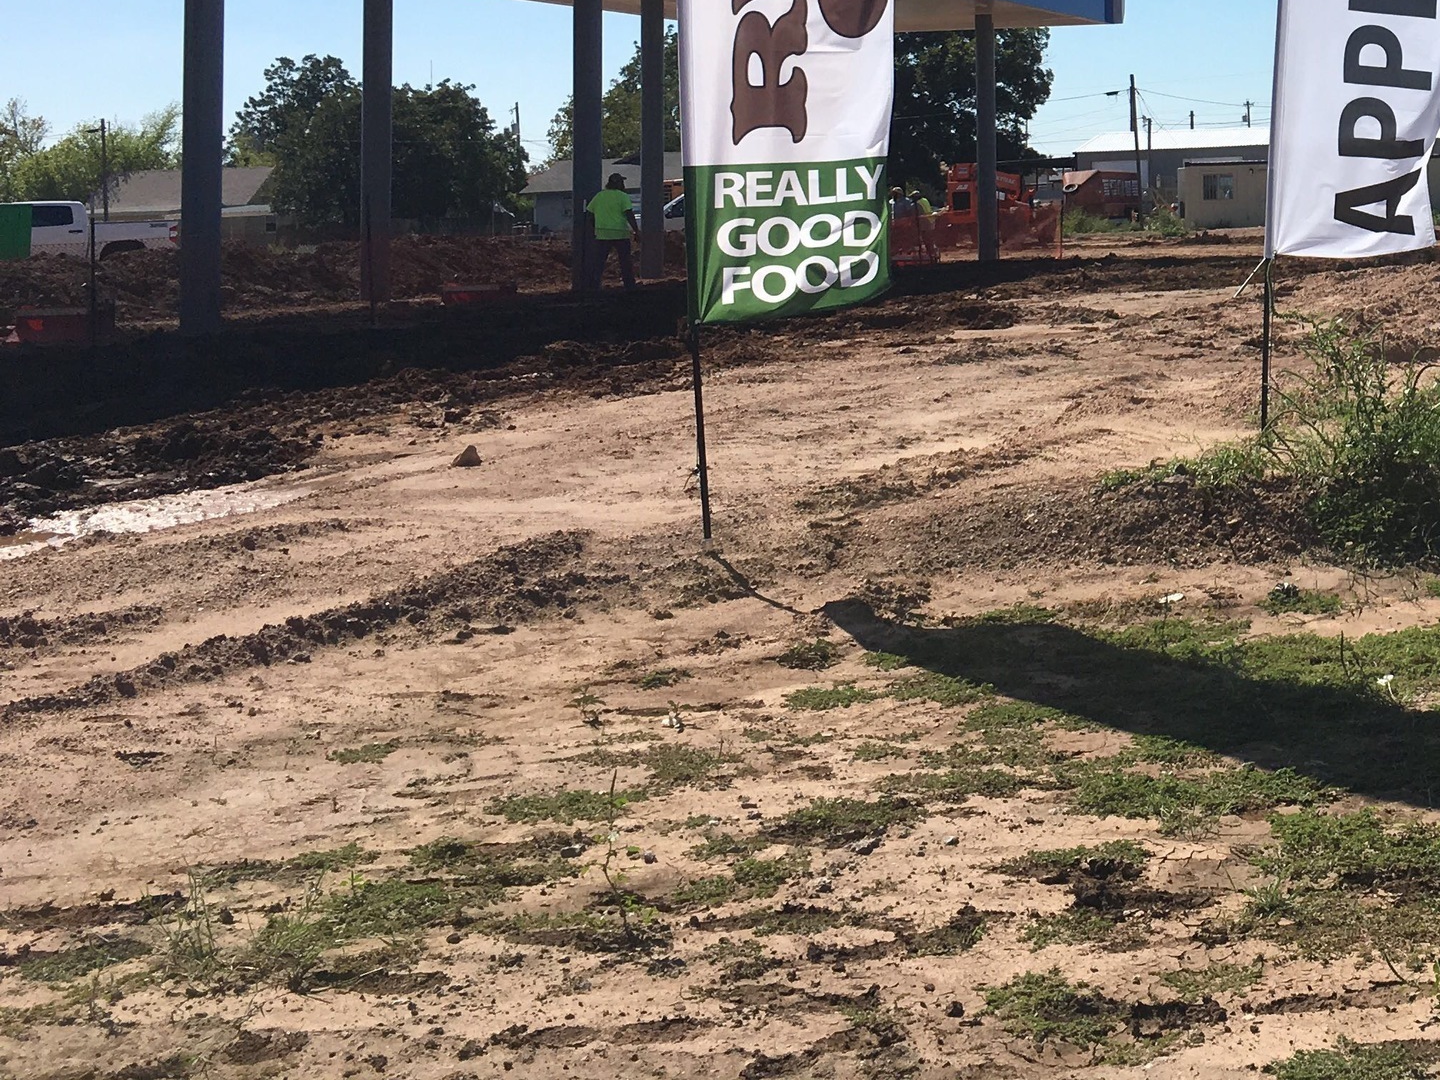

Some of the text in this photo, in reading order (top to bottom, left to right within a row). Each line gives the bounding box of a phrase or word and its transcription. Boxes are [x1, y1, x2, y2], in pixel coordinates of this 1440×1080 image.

[713, 164, 885, 209] REALLY
[717, 209, 882, 258] GOOD
[721, 250, 880, 305] FOOD
